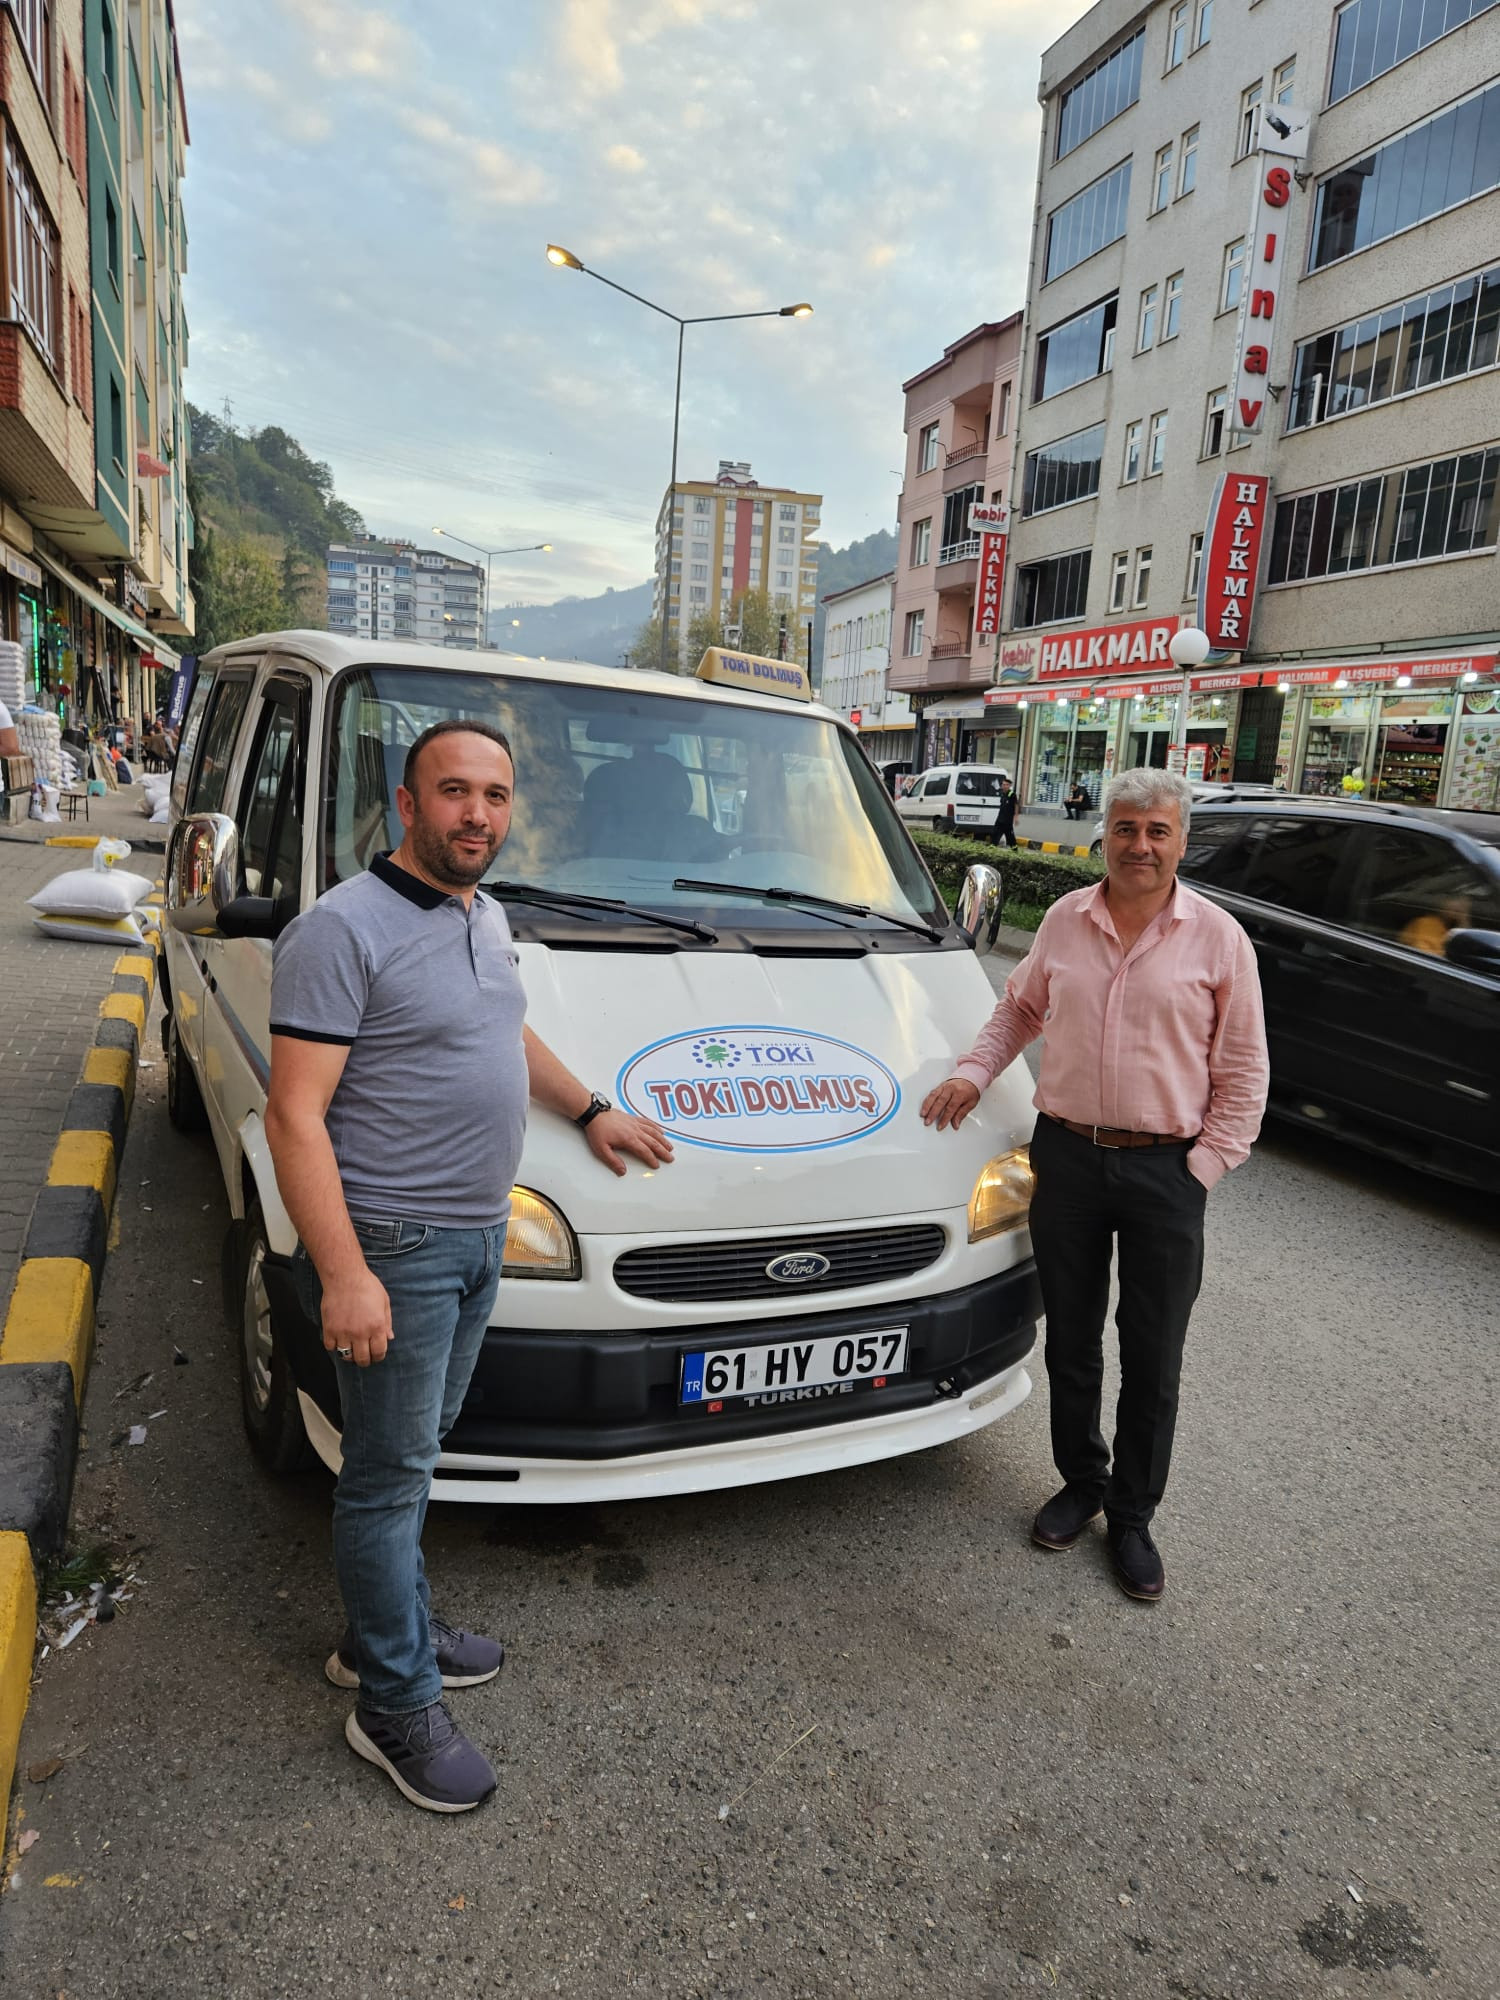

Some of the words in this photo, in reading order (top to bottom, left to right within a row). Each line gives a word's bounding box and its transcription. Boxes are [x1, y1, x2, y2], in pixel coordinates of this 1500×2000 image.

[972, 505, 1007, 522] kebir
[1218, 482, 1259, 639] HALKMAR
[981, 536, 1002, 632] HALKMAR
[1001, 641, 1035, 667] kebir
[1041, 627, 1170, 673] HALKMAR
[753, 662, 803, 689] DOLMUŞ
[1199, 675, 1240, 689] MERKEZİ
[1411, 658, 1472, 676] MERKEZİ
[171, 675, 185, 719] Buderus
[740, 1078, 875, 1113] DOLMUŞ
[781, 1258, 816, 1276] Ford
[705, 1352, 746, 1394] 61
[765, 1344, 814, 1386] HY
[832, 1333, 902, 1377] 057
[685, 1379, 701, 1393] TR
